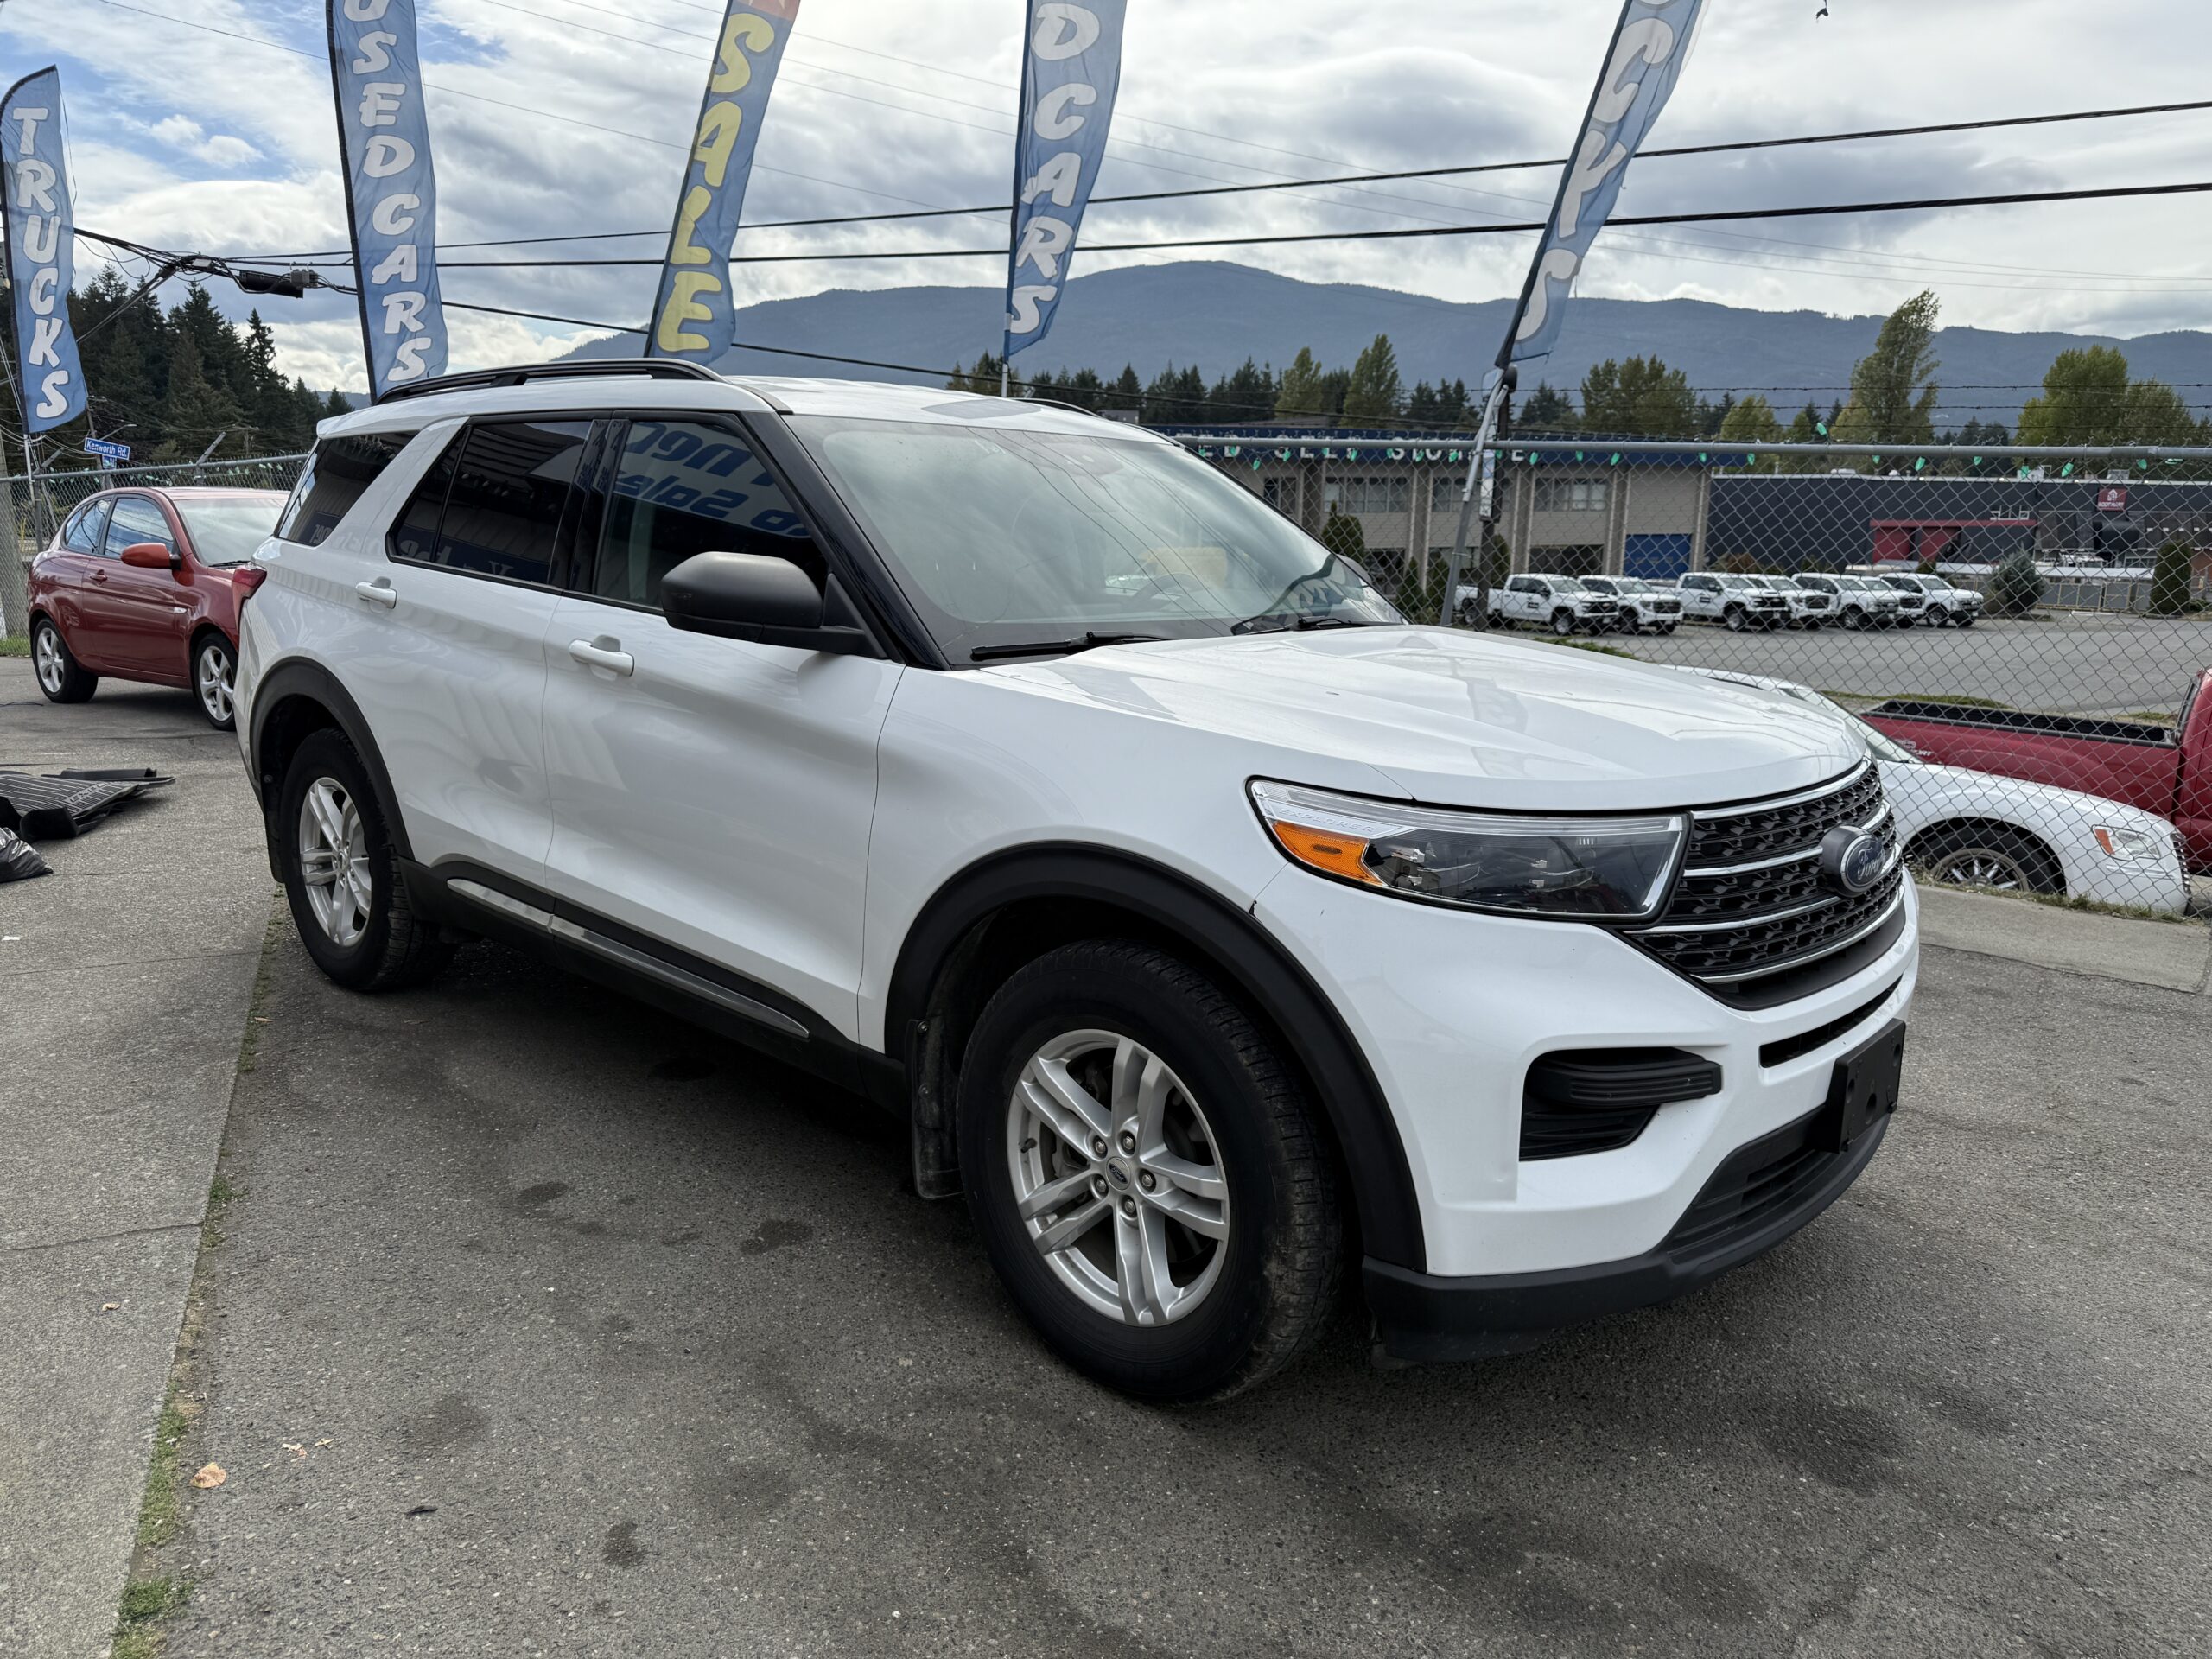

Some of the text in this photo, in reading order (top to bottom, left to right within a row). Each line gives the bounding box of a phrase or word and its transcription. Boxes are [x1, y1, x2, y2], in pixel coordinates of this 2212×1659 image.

[12, 107, 69, 419] TRUCKS
[371, 193, 432, 382] CARS
[657, 13, 774, 353] SALE
[1010, 82, 1096, 334] CARS
[1279, 808, 1375, 832] EXPLORER
[1857, 843, 1885, 881] Ford
